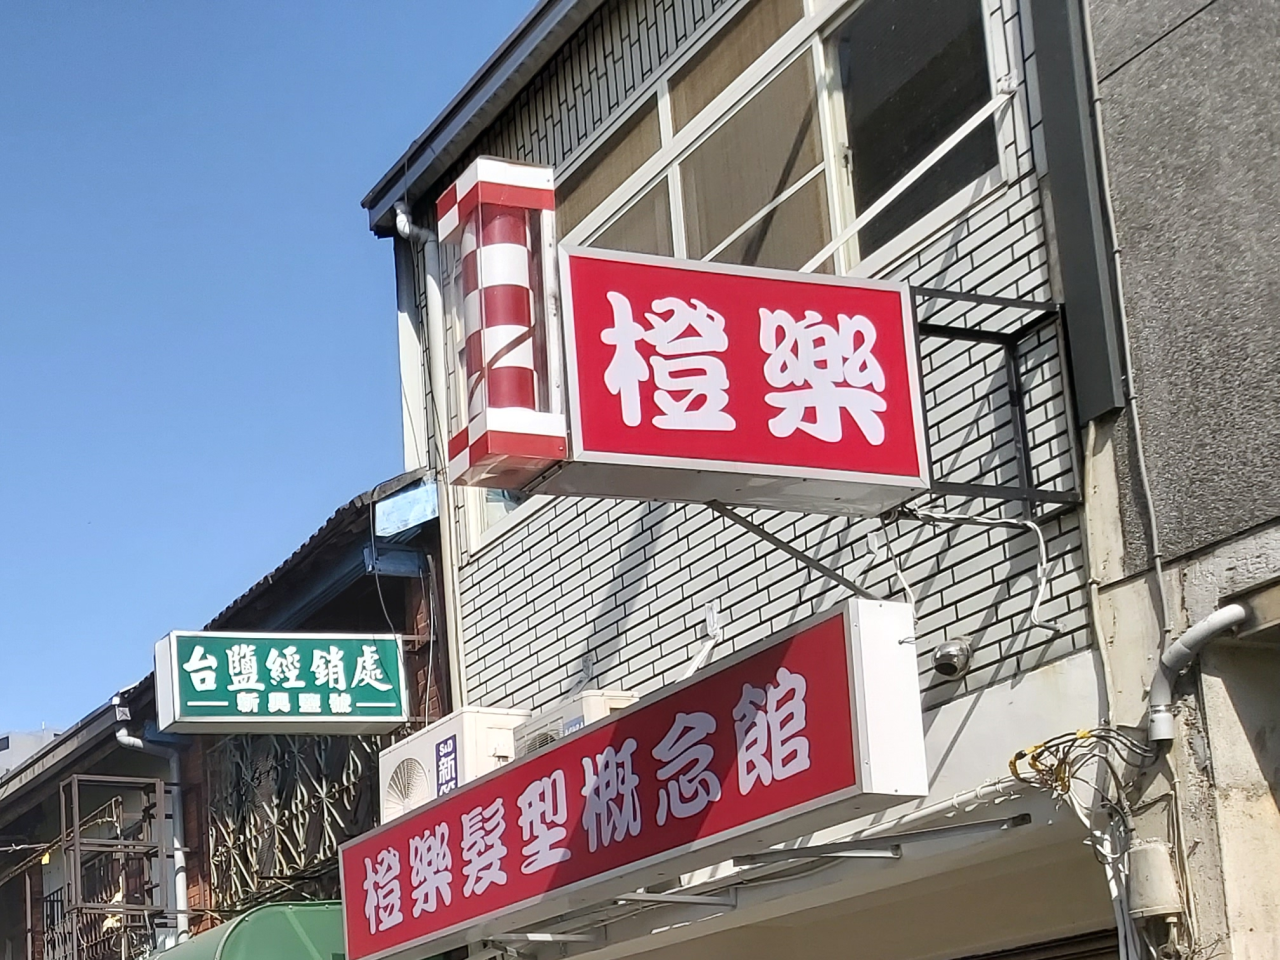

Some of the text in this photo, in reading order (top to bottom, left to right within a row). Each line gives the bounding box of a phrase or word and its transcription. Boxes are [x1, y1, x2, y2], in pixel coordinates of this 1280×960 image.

[600, 290, 888, 446] 橙樂
[182, 643, 394, 692] 台鹽經銷處
[363, 666, 812, 935] 橙樂髮型概念館
